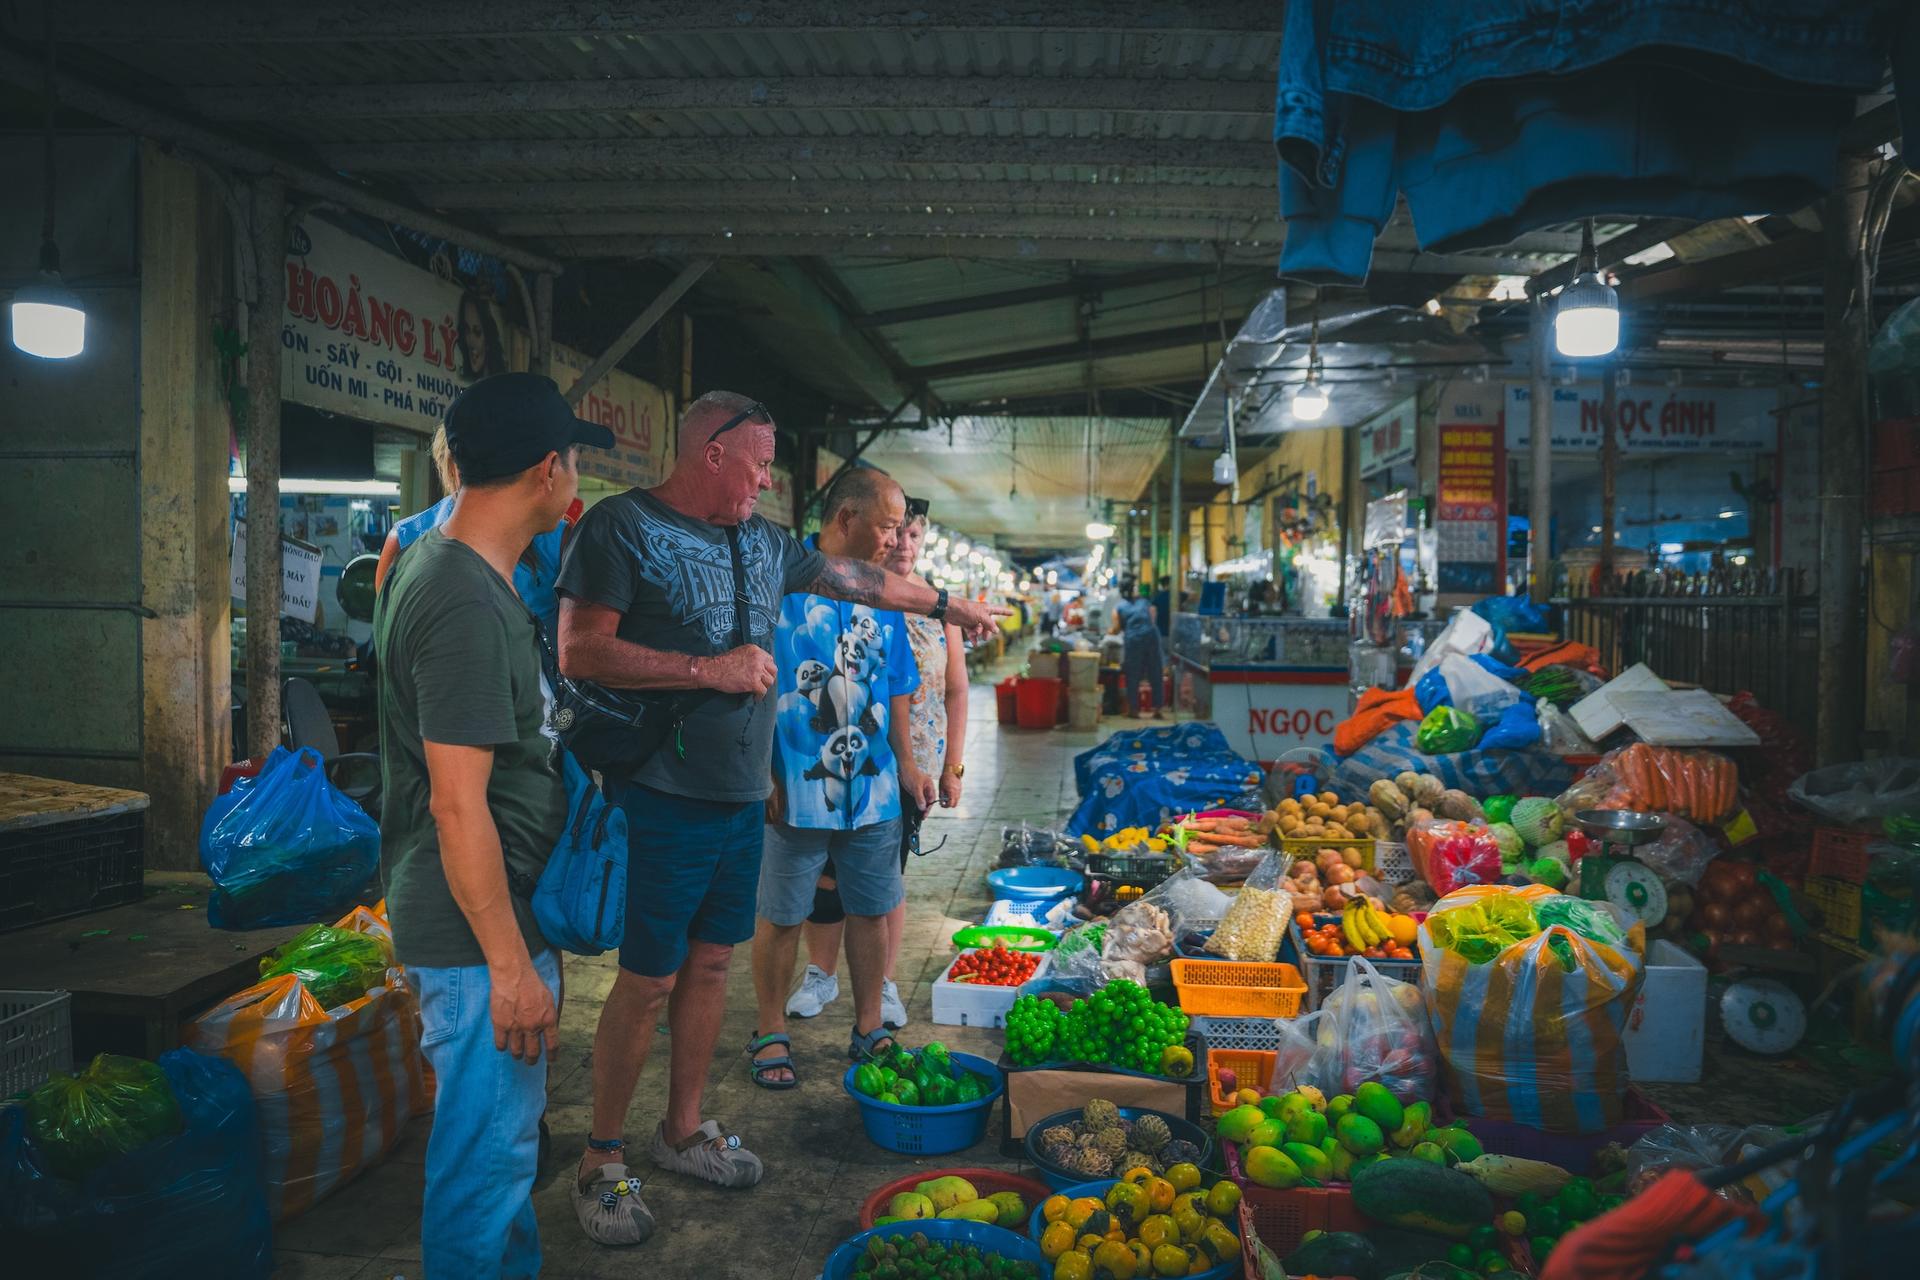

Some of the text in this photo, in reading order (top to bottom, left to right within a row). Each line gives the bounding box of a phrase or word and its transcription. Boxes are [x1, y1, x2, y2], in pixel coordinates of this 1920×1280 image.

[281, 324, 309, 353] ỐN
[348, 377, 368, 399] MI
[1248, 708, 1335, 740] NGỌC
